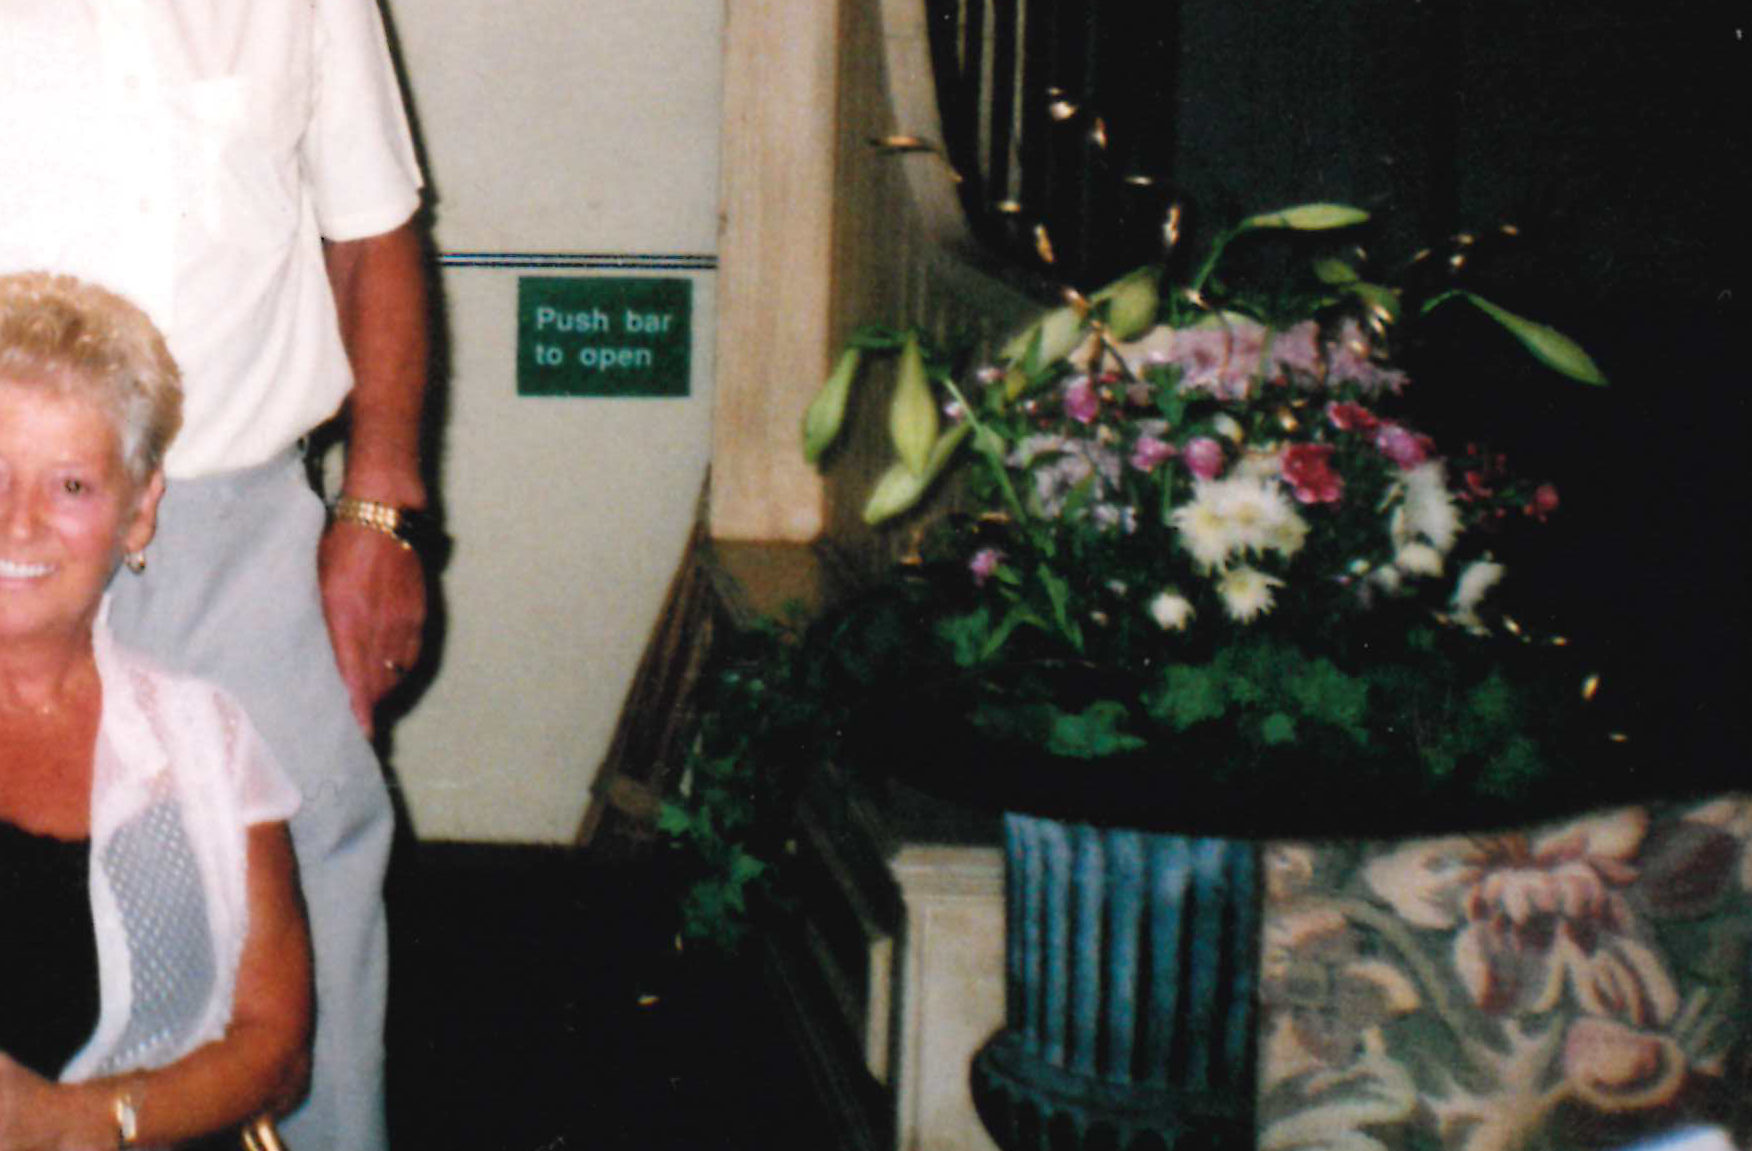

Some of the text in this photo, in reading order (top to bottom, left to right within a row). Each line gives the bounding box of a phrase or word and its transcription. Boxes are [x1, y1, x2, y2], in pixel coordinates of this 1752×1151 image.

[536, 307, 673, 333] Push bar
[535, 345, 652, 371] to open
